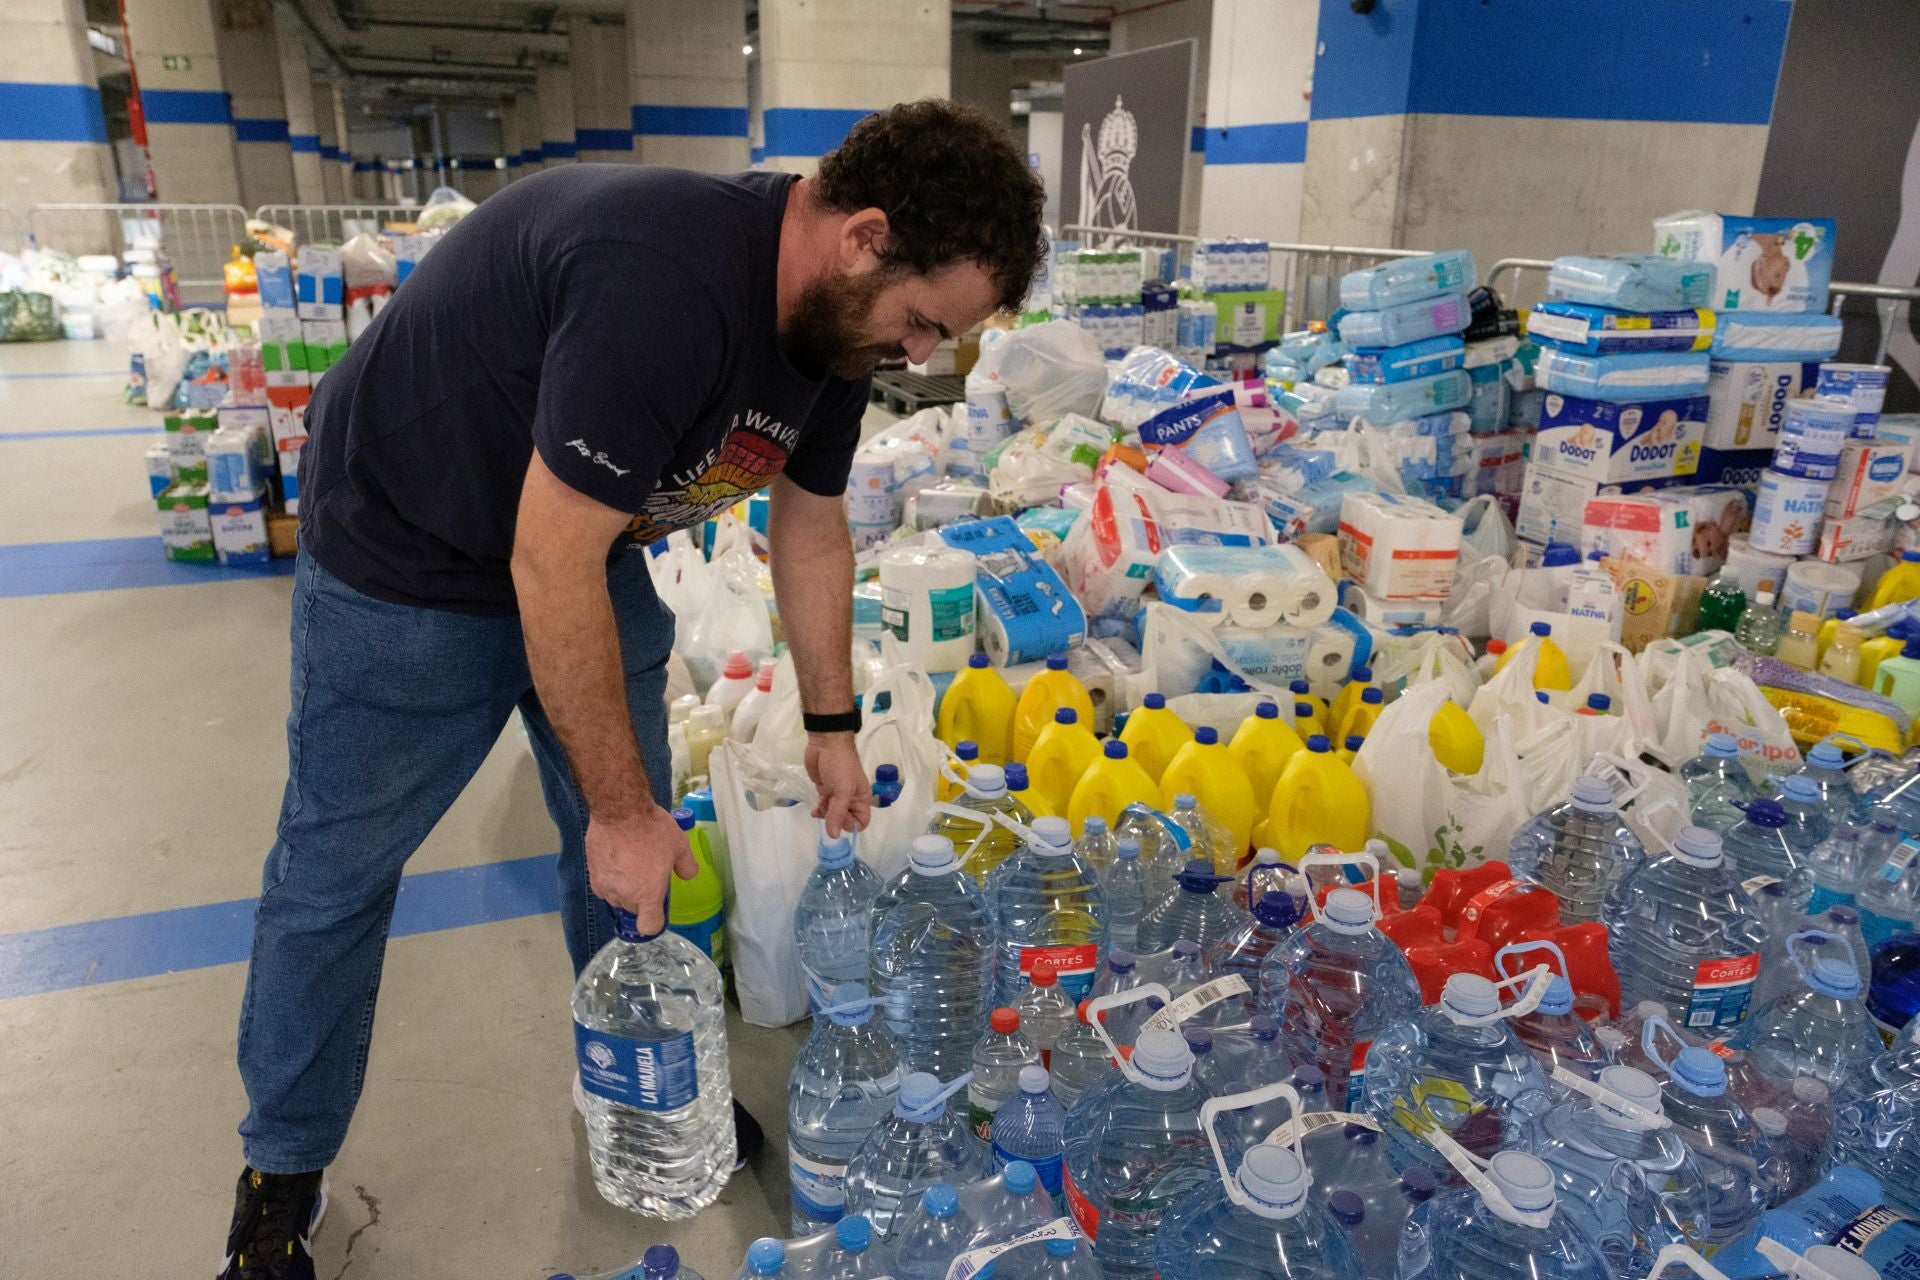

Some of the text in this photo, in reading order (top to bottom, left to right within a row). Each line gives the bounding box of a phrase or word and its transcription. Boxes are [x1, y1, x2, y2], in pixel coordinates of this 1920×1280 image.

[1766, 374, 1793, 435] DODOT
[1157, 413, 1202, 440] PANTS
[1559, 441, 1597, 461] DODOT
[1630, 443, 1678, 462] DODOT
[673, 448, 716, 487] LIFE
[1721, 466, 1761, 485] DODO
[1571, 607, 1606, 620] NATIVA
[1271, 663, 1303, 675] doble
[1034, 954, 1084, 966] CORTES
[1710, 964, 1752, 979] CORTES
[641, 1091, 658, 1104] LA
